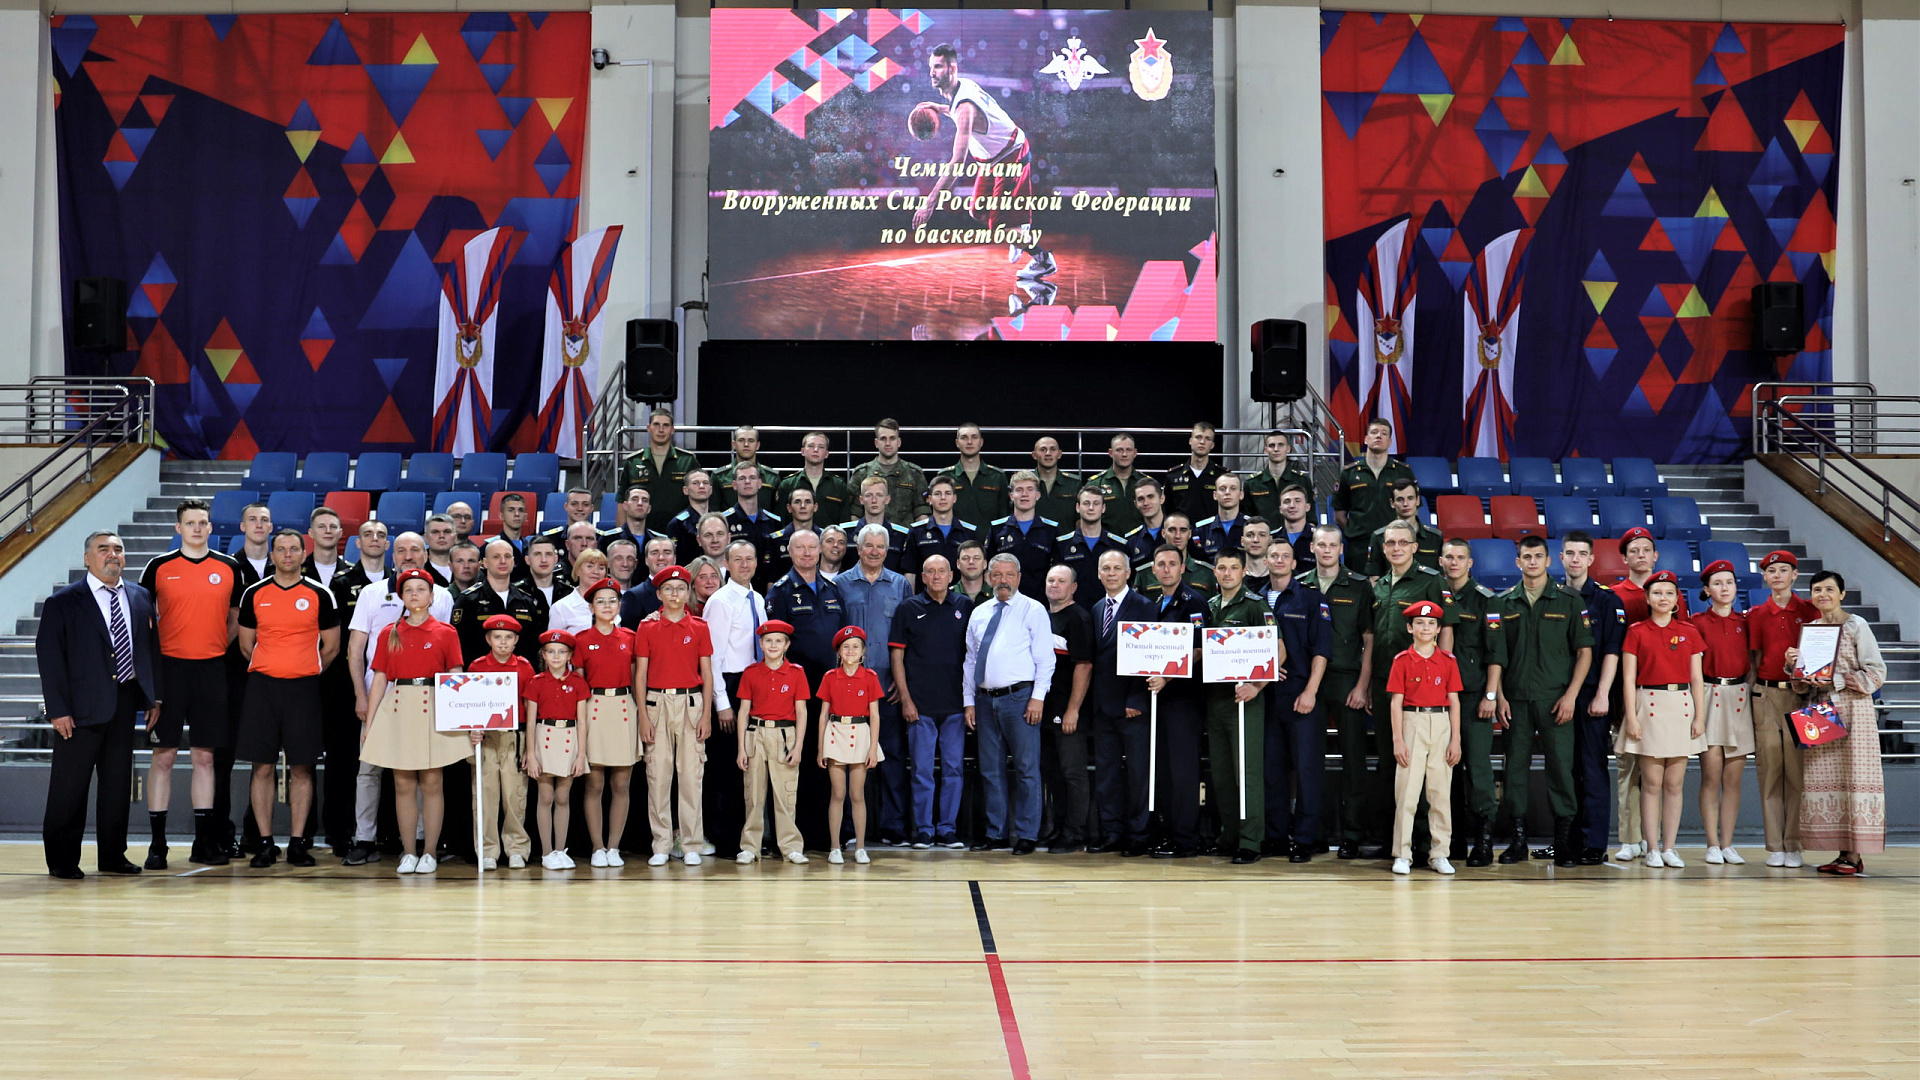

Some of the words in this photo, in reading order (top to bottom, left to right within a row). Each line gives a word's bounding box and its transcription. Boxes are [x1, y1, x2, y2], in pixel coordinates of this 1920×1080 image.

[893, 155, 1024, 180] Чемпионат
[722, 189, 879, 215] Вооруженных
[886, 190, 928, 213] Сил
[935, 188, 1062, 213] Российской
[1070, 189, 1192, 216] Федерации
[880, 226, 908, 245] по
[915, 223, 1042, 248] баскетболу
[1125, 642, 1153, 650] Южный
[448, 700, 486, 709] Северный
[488, 700, 505, 709] флот
